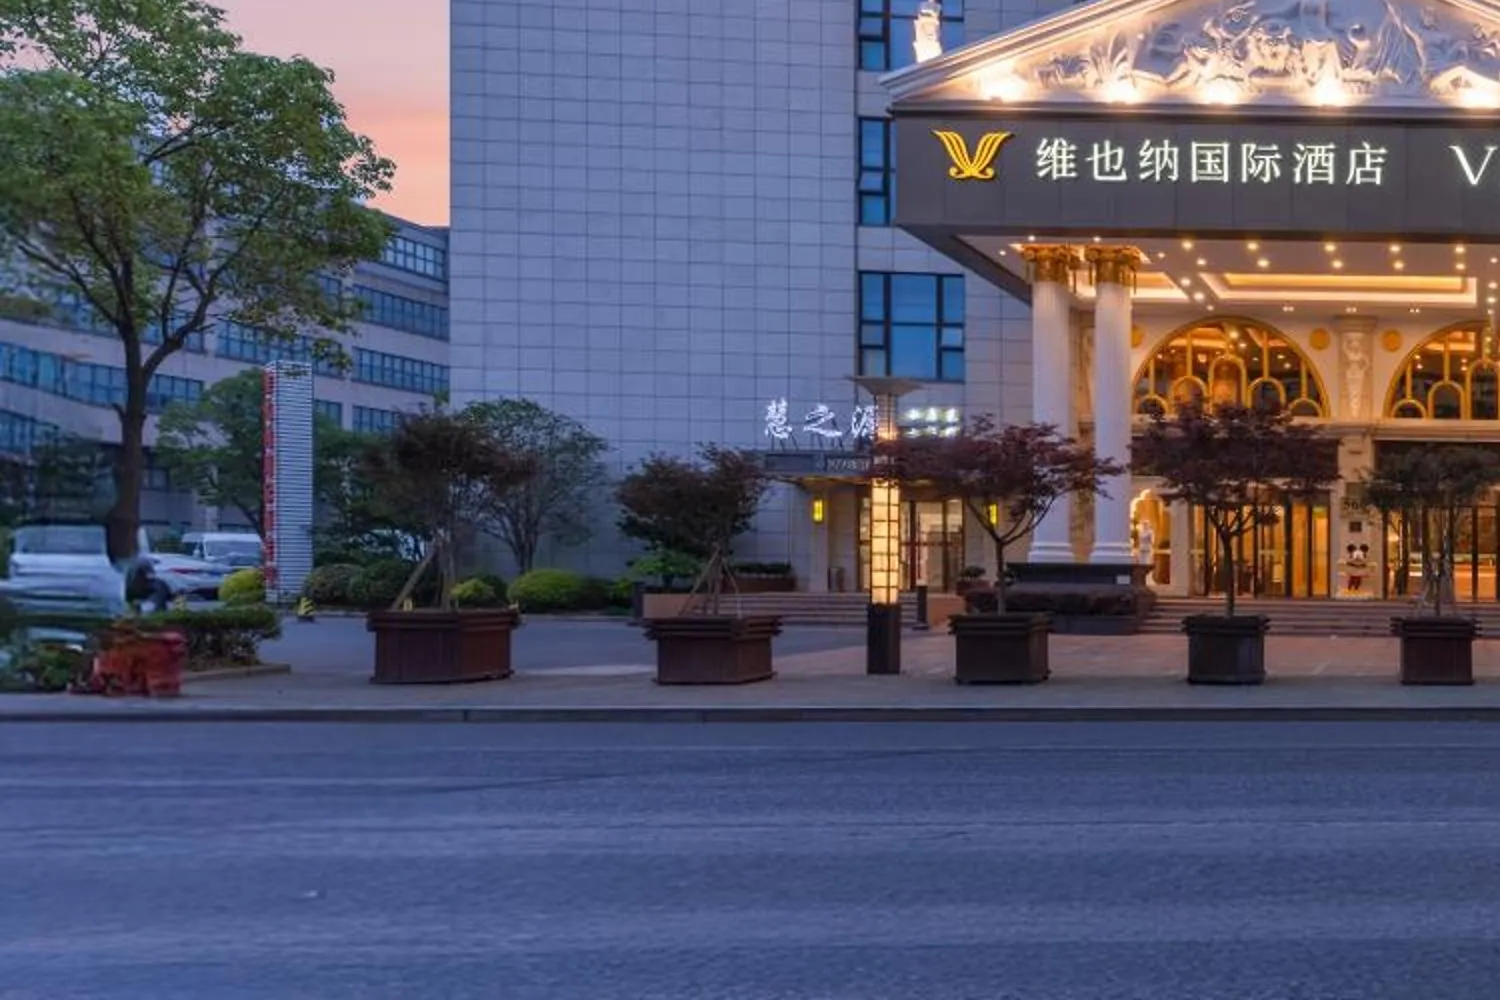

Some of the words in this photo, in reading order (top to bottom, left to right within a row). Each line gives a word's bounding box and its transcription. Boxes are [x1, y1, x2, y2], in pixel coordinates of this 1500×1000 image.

[1034, 136, 1389, 186] 维也纳国际酒店
